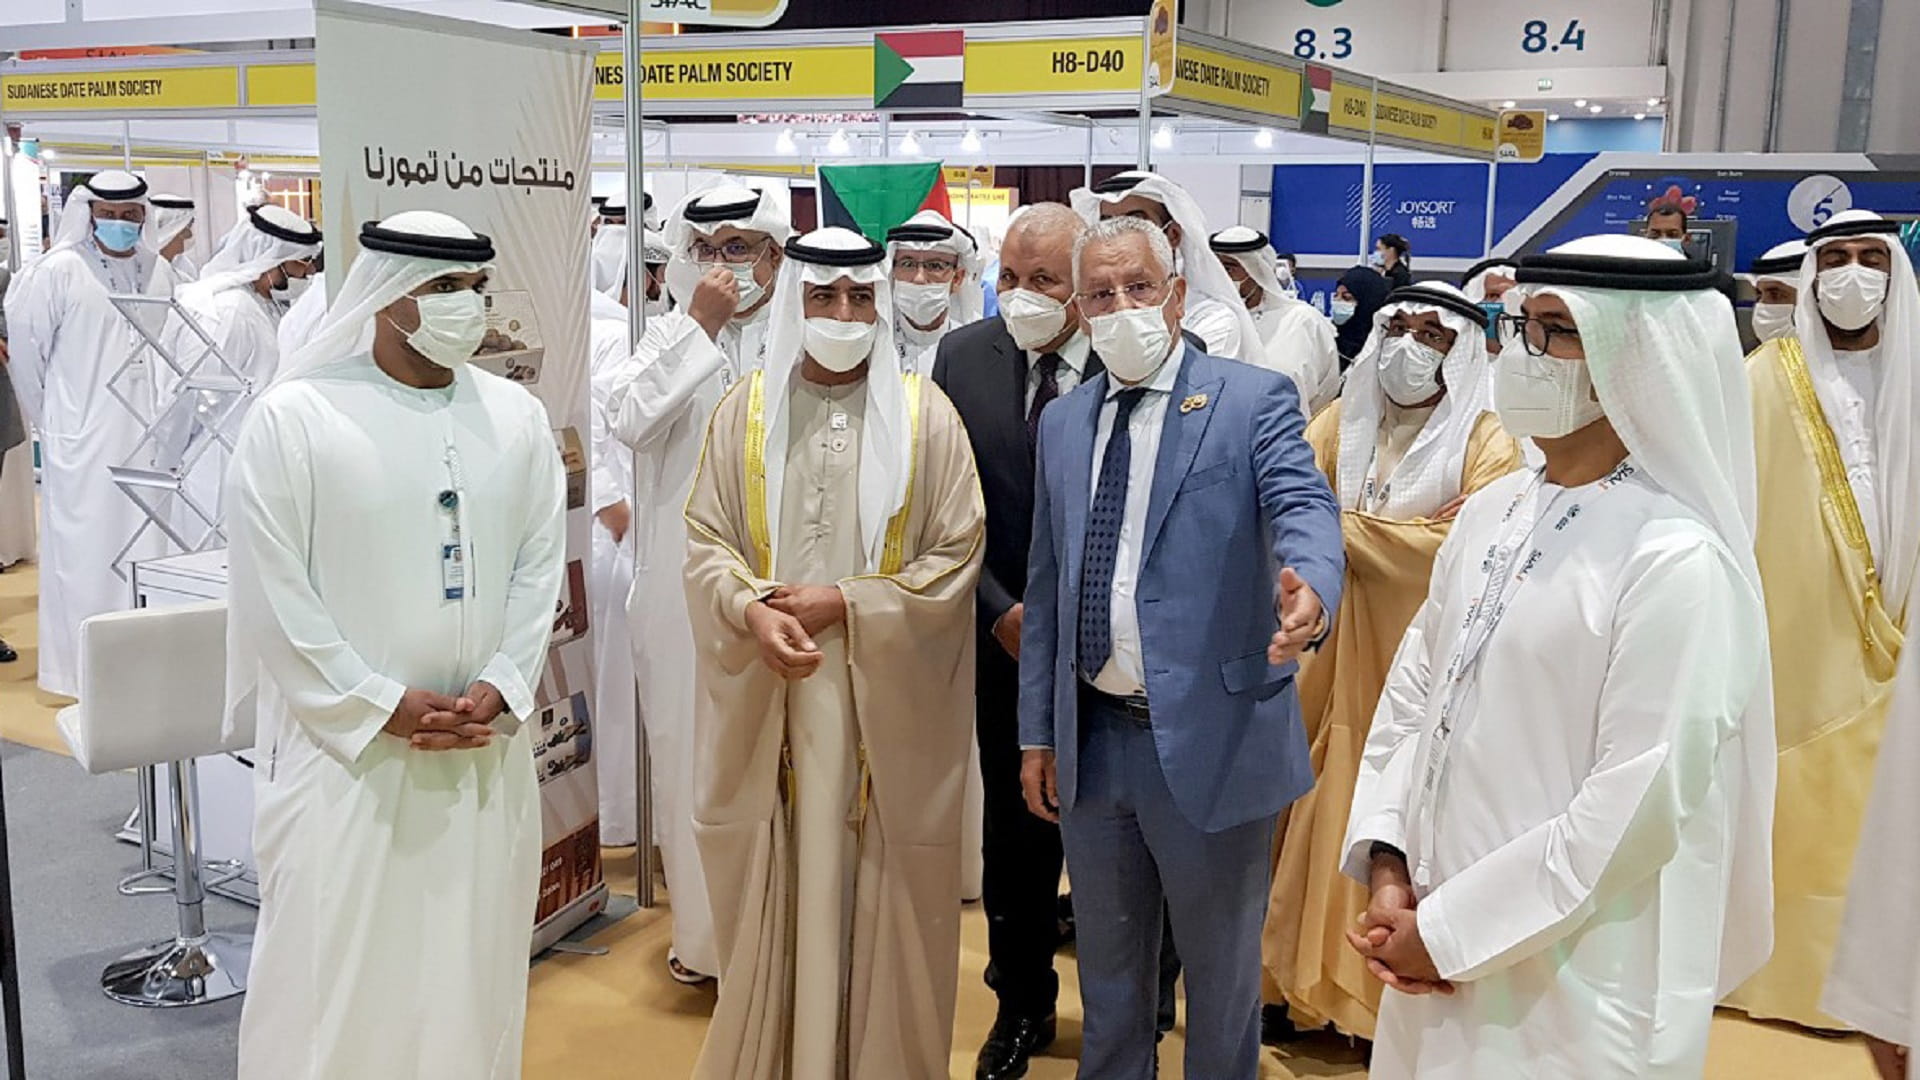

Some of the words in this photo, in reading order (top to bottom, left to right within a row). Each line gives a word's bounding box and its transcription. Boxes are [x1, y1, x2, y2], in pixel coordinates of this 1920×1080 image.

[1294, 27, 1352, 59] 8.3
[1522, 20, 1585, 53] 8.4
[679, 62, 722, 83] PALM
[726, 61, 793, 82] SOCIETY
[1052, 50, 1124, 74] H8-D40
[7, 83, 58, 100] SUDANESE
[60, 82, 86, 98] DATE
[88, 81, 117, 97] PALM
[119, 79, 163, 97] SOCIETY
[1200, 63, 1220, 86] DATE
[1221, 67, 1241, 91] PALM
[1242, 73, 1270, 96] SOCIETY
[364, 146, 439, 188] تمورنا
[444, 152, 483, 190] من
[489, 156, 576, 195] منتجات
[1396, 201, 1456, 214] JOYSORT
